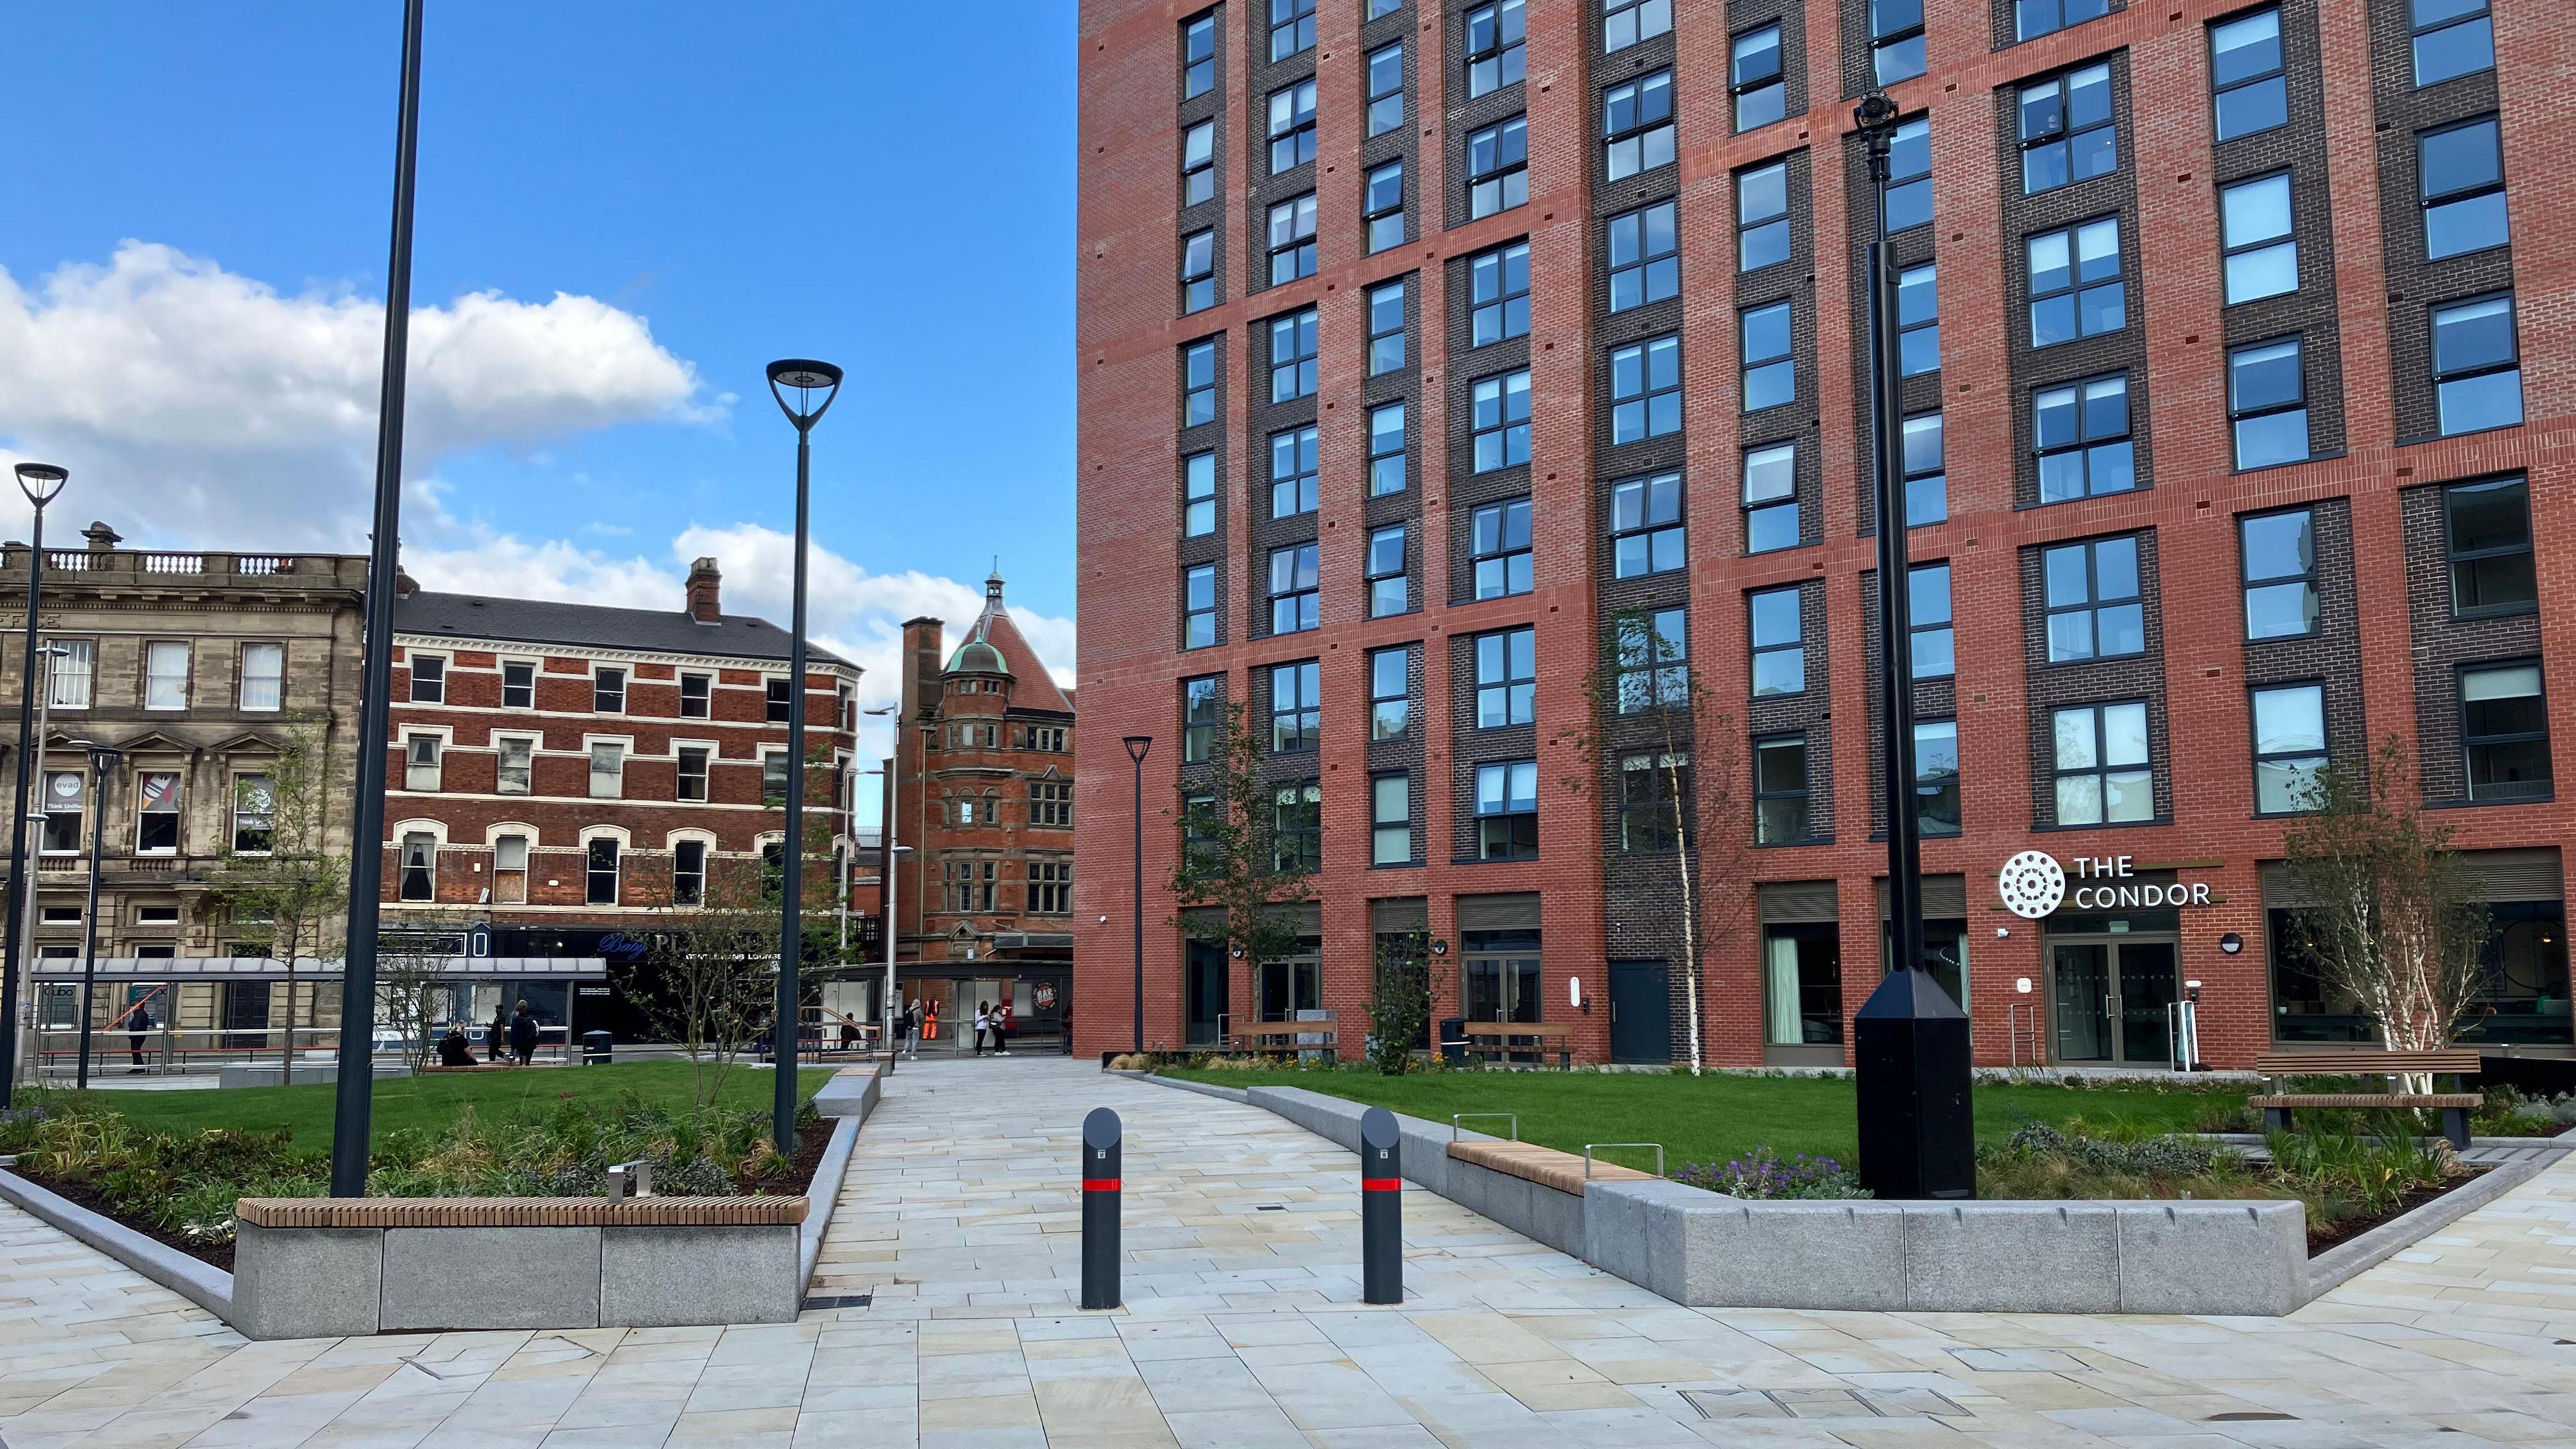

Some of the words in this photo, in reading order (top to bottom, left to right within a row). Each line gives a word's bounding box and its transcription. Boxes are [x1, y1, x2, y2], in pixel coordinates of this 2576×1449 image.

[2074, 855, 2134, 879] THE
[2076, 883, 2211, 909] CONDOR
[597, 933, 645, 960] Baby
[1037, 987, 1054, 1003] BAR
